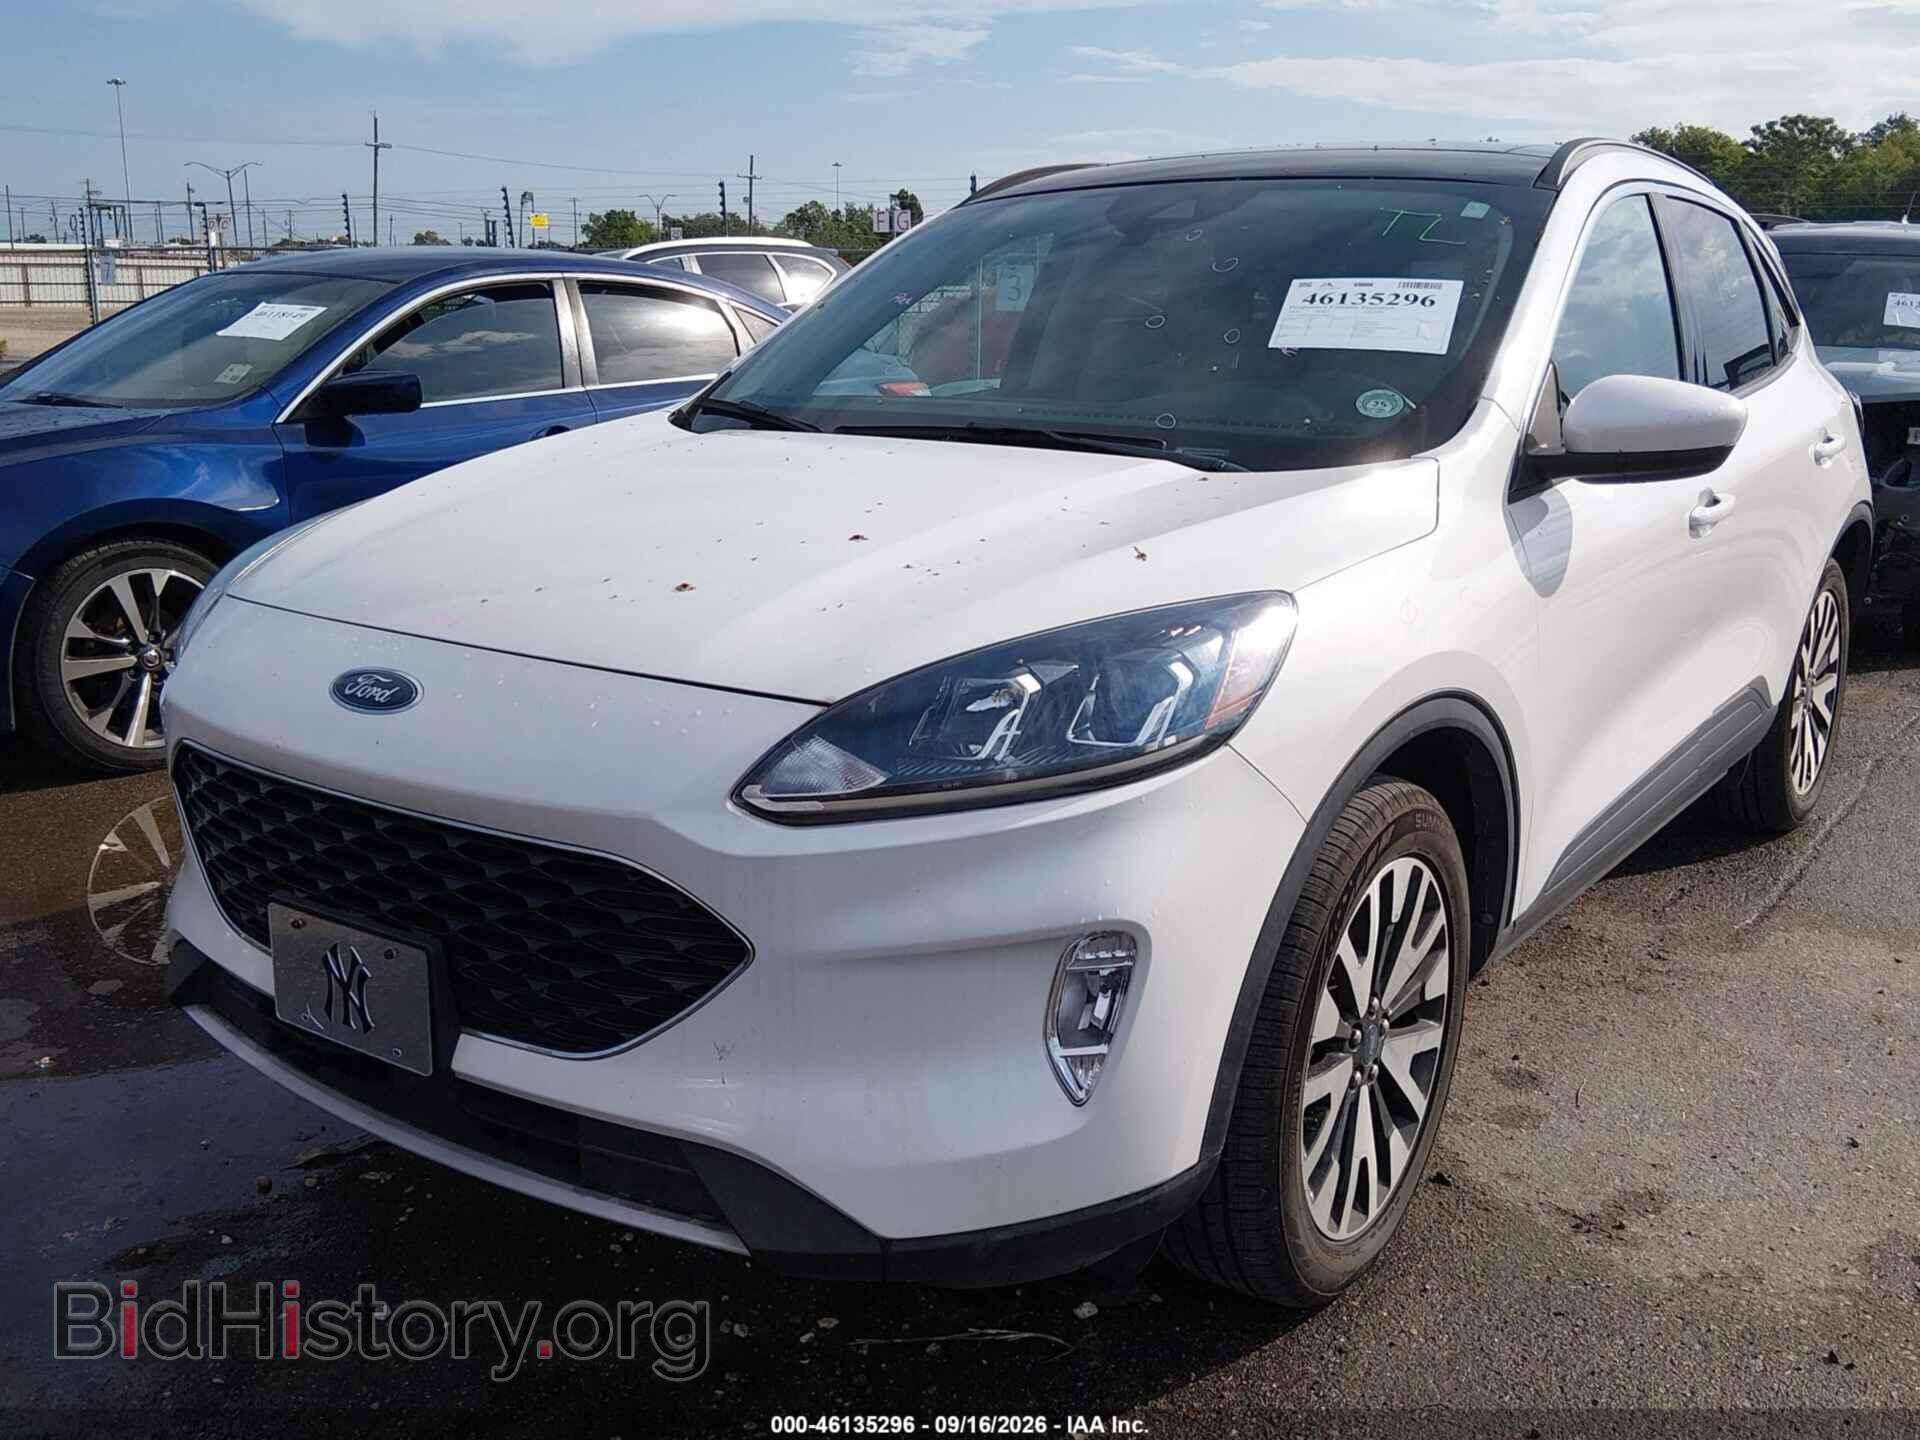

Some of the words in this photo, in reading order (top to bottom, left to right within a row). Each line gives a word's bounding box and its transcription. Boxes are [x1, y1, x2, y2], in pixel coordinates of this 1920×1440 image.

[876, 211, 885, 231] F
[896, 211, 909, 231] G
[1007, 274, 1022, 302] 3
[1302, 291, 1437, 308] 46135296
[344, 673, 401, 703] Ford
